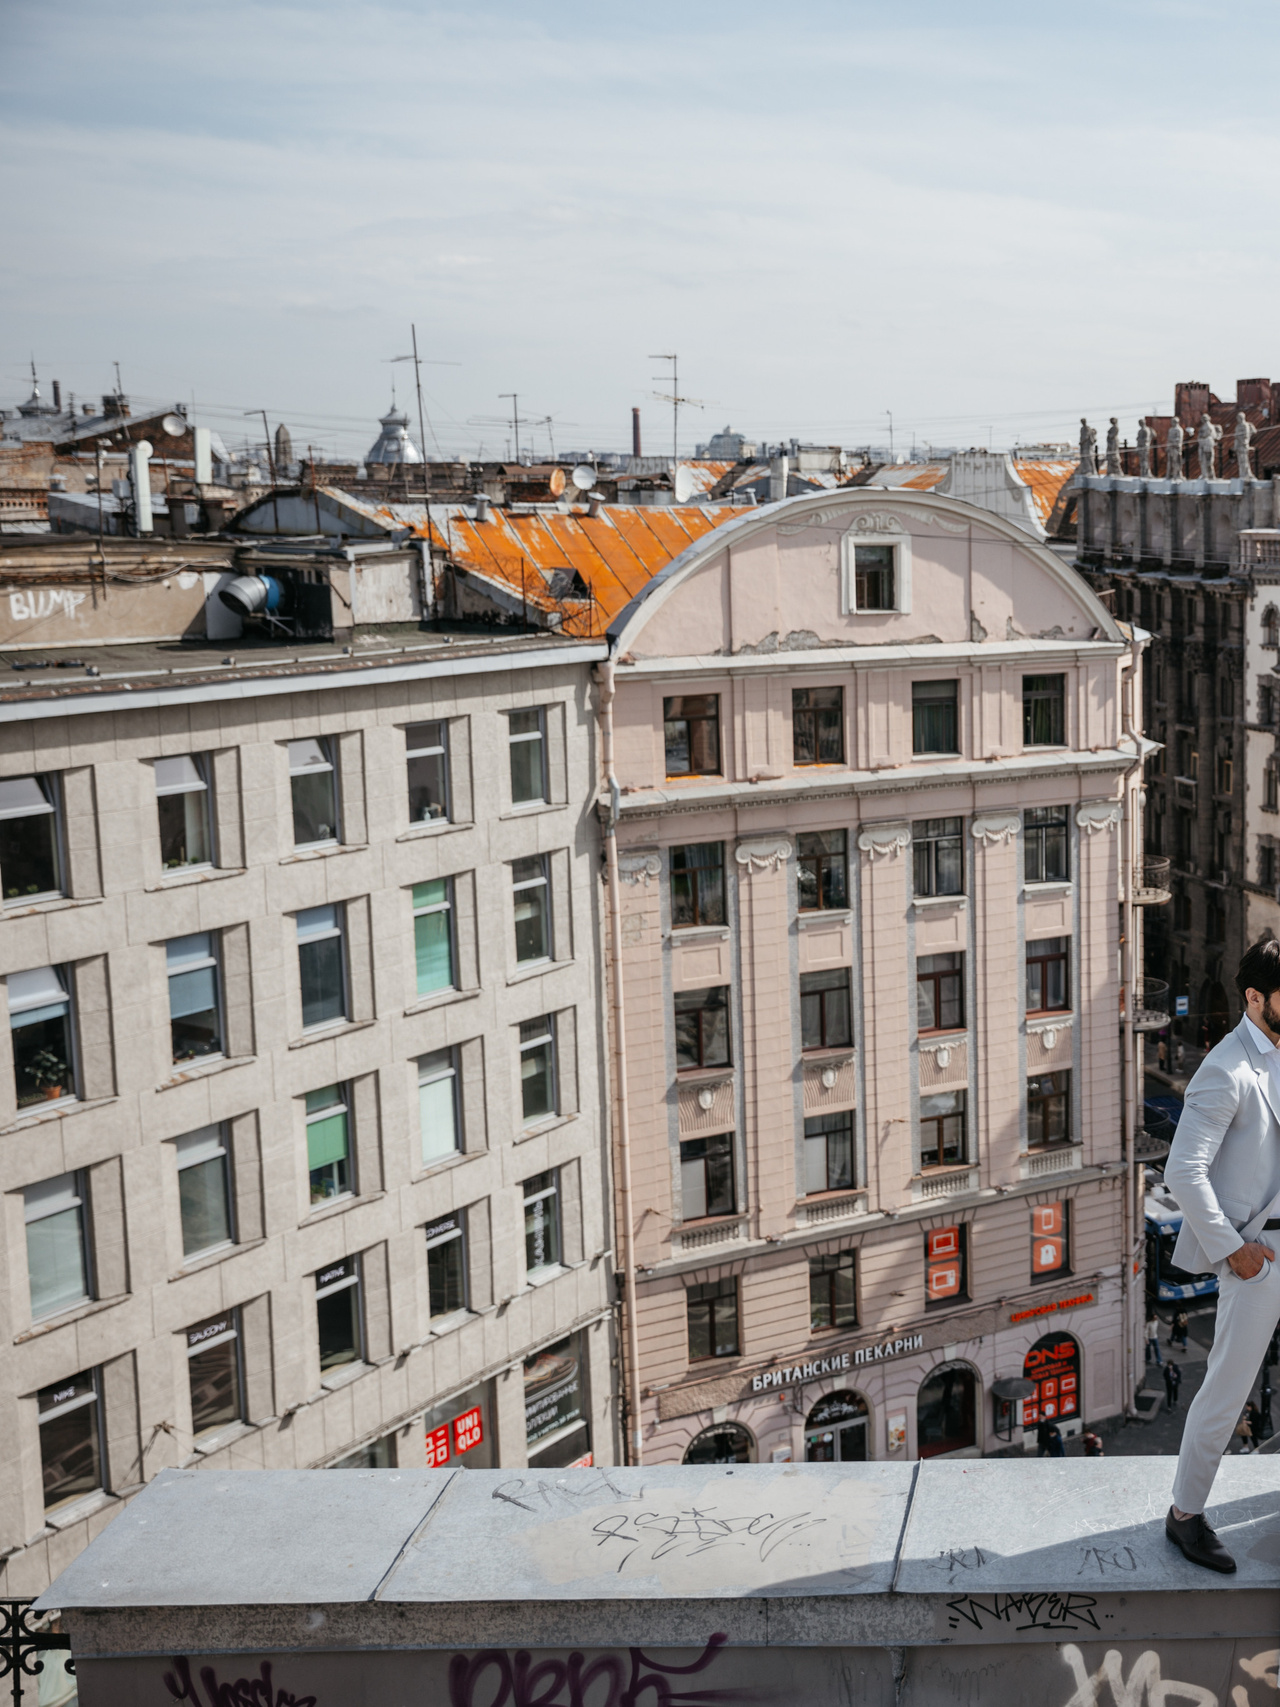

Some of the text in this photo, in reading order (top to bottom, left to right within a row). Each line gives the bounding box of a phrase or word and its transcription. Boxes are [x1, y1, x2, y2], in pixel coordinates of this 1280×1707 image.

[752, 1334, 924, 1392] БРИТАНСКИЕ ПЕКАРНИ
[1025, 1341, 1075, 1368] DNS
[53, 1385, 76, 1403] NIKE
[456, 1411, 478, 1435] UNI
[458, 1426, 481, 1451] QLO
